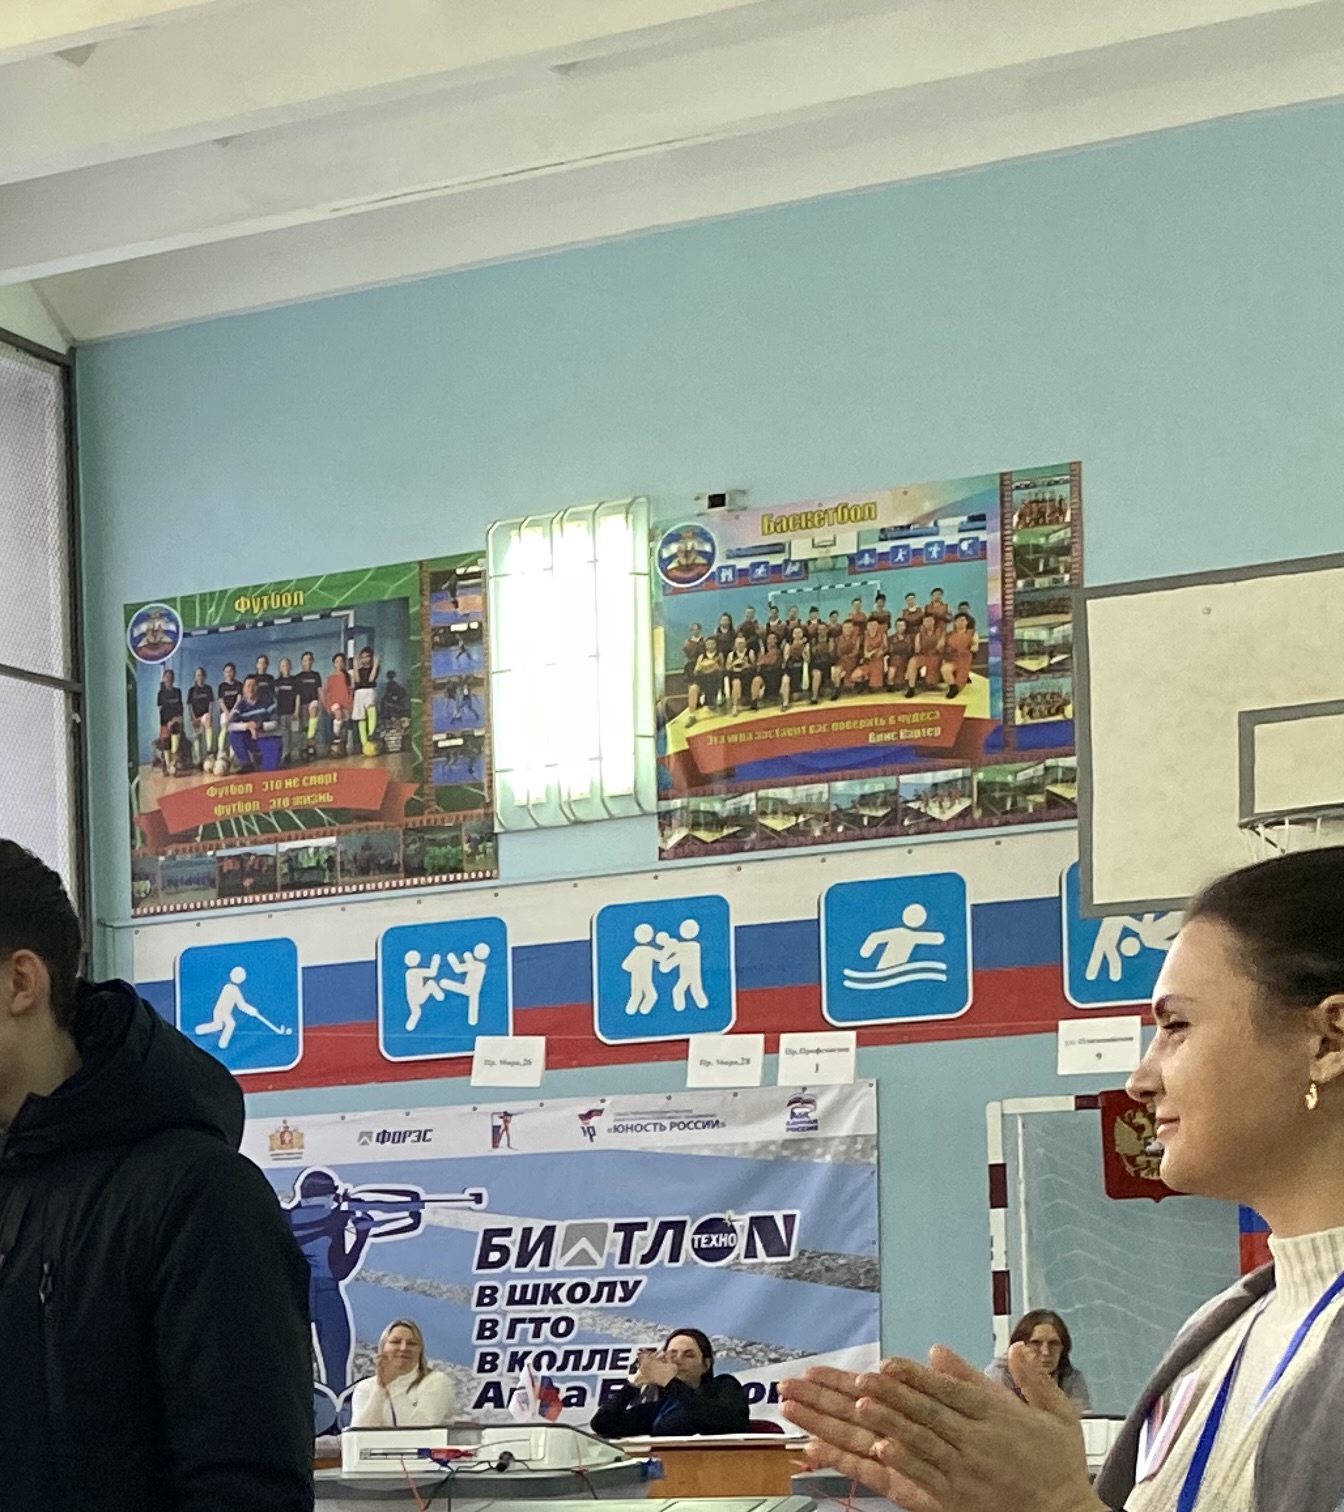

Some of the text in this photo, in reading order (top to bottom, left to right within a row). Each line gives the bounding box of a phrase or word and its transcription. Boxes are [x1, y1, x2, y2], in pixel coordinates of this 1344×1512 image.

[762, 501, 878, 536] Баскетбол
[234, 590, 305, 614] Футбол
[206, 783, 253, 798] Футбол
[302, 772, 338, 788] спорт
[375, 1127, 434, 1145] ФОРЭС
[692, 1231, 737, 1249] ТЕХНО
[475, 1279, 644, 1307] В ШКОЛУ
[475, 1316, 575, 1340] В ГТО
[476, 1352, 499, 1373] В
